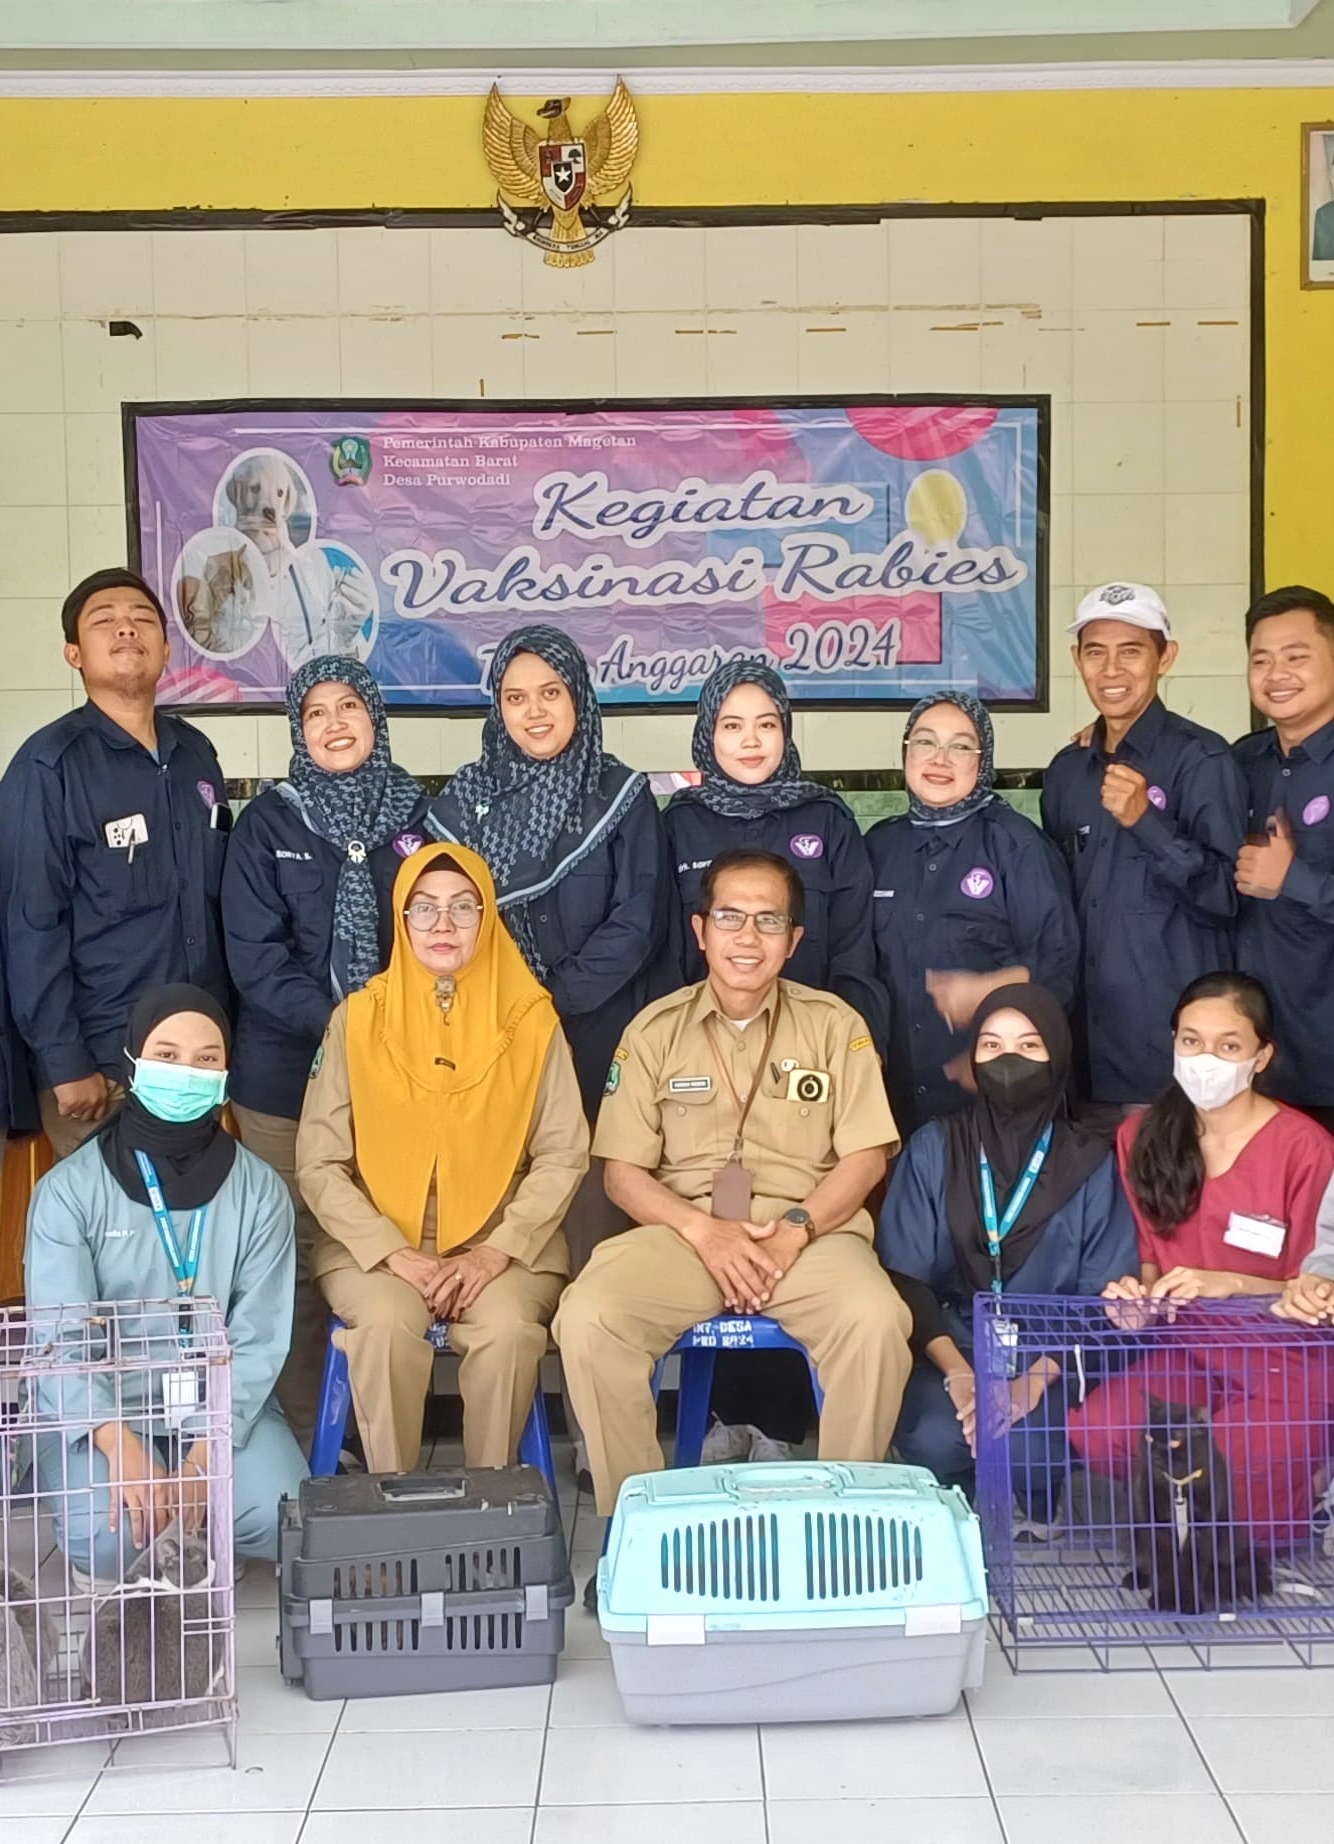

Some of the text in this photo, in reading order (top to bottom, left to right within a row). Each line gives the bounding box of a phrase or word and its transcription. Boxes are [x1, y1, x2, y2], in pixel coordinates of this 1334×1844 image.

[384, 435, 636, 450] Pemerintah Kabupaten Magetan
[383, 454, 518, 468] Kecamatan Barat
[383, 473, 511, 486] Desa Purwodadi
[541, 480, 865, 540] Kegiatan
[389, 539, 1018, 609] Vaksinasi Rabies
[788, 624, 897, 671] 2024
